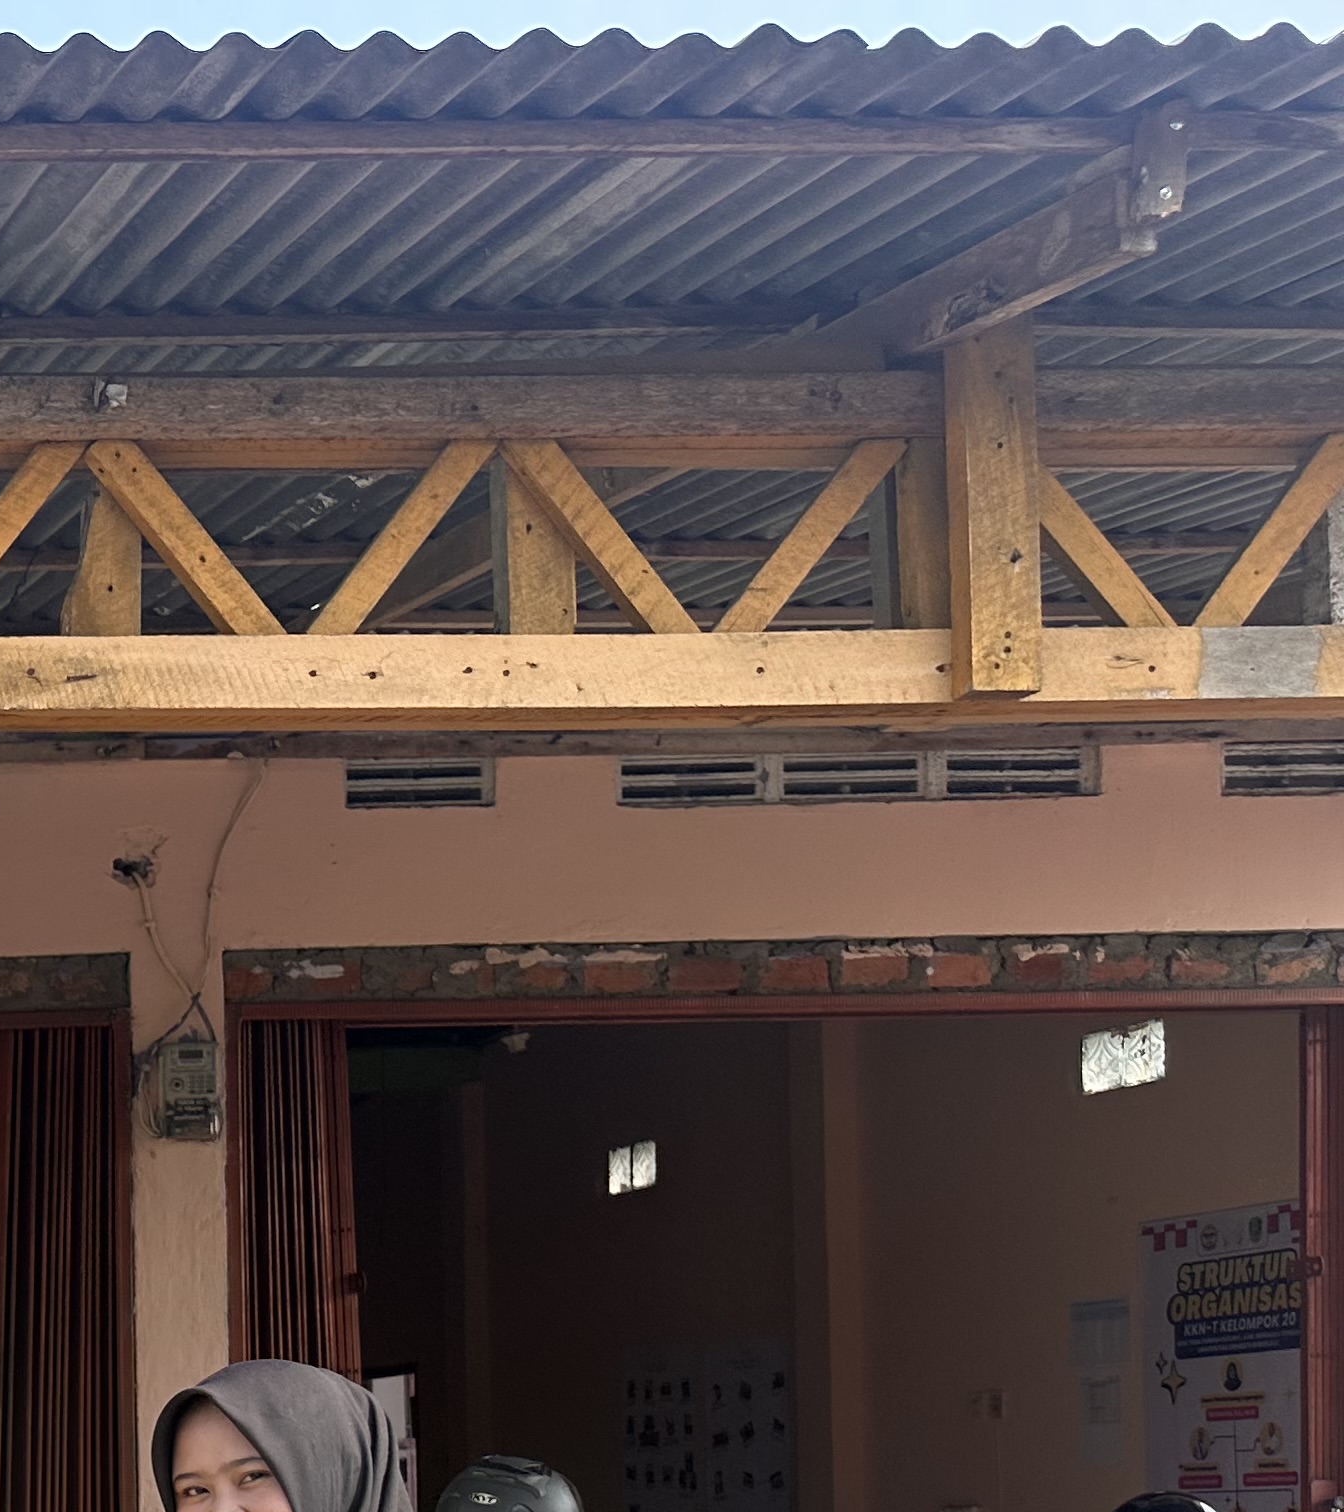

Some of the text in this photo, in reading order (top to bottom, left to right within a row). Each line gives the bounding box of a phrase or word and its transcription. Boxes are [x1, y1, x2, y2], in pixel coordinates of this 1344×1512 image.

[1169, 1280, 1301, 1323] ORGANISAS
[1184, 1311, 1297, 1337] KKN-T KELOMPOK 20
